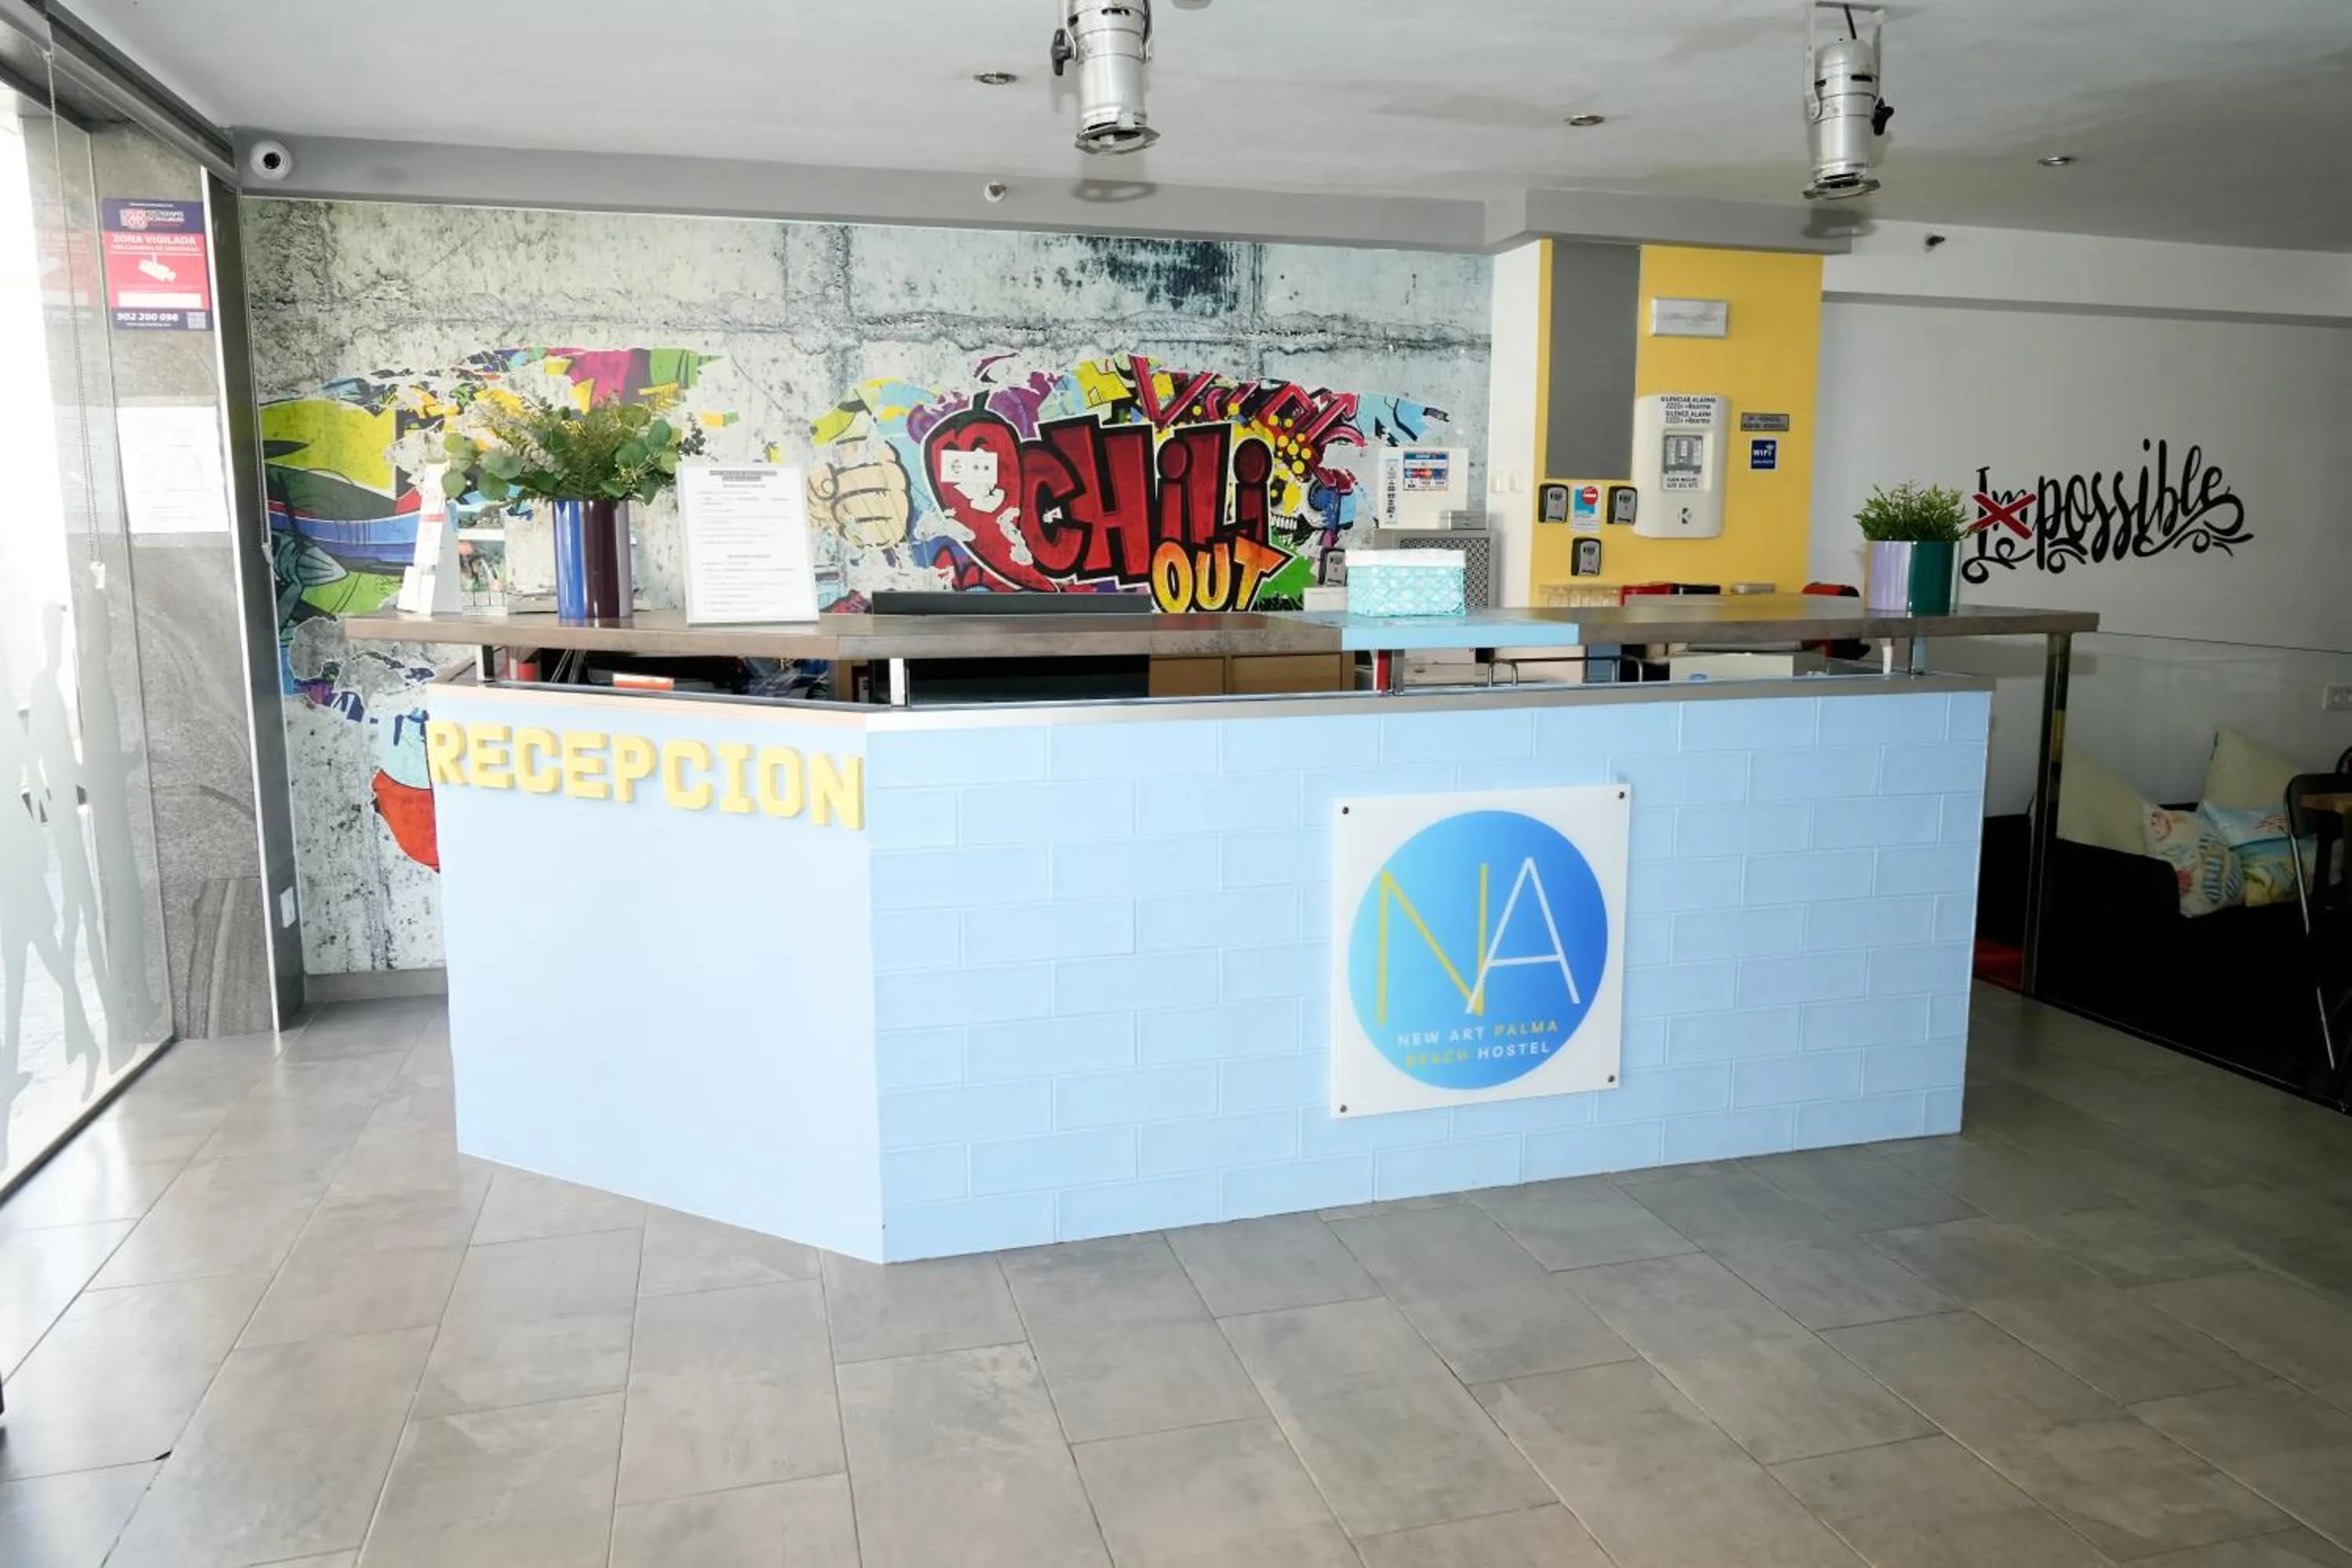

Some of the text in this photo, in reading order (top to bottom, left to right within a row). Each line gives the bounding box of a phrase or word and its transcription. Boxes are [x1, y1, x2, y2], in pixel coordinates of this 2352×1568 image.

[112, 234, 196, 245] ZONA VIGILADA
[1152, 538, 1289, 614] OUT
[425, 721, 863, 830] RECEPCION
[1397, 1020, 1559, 1047] NEW ART PALMA
[1406, 1041, 1550, 1068] BEACH HOSTEL
